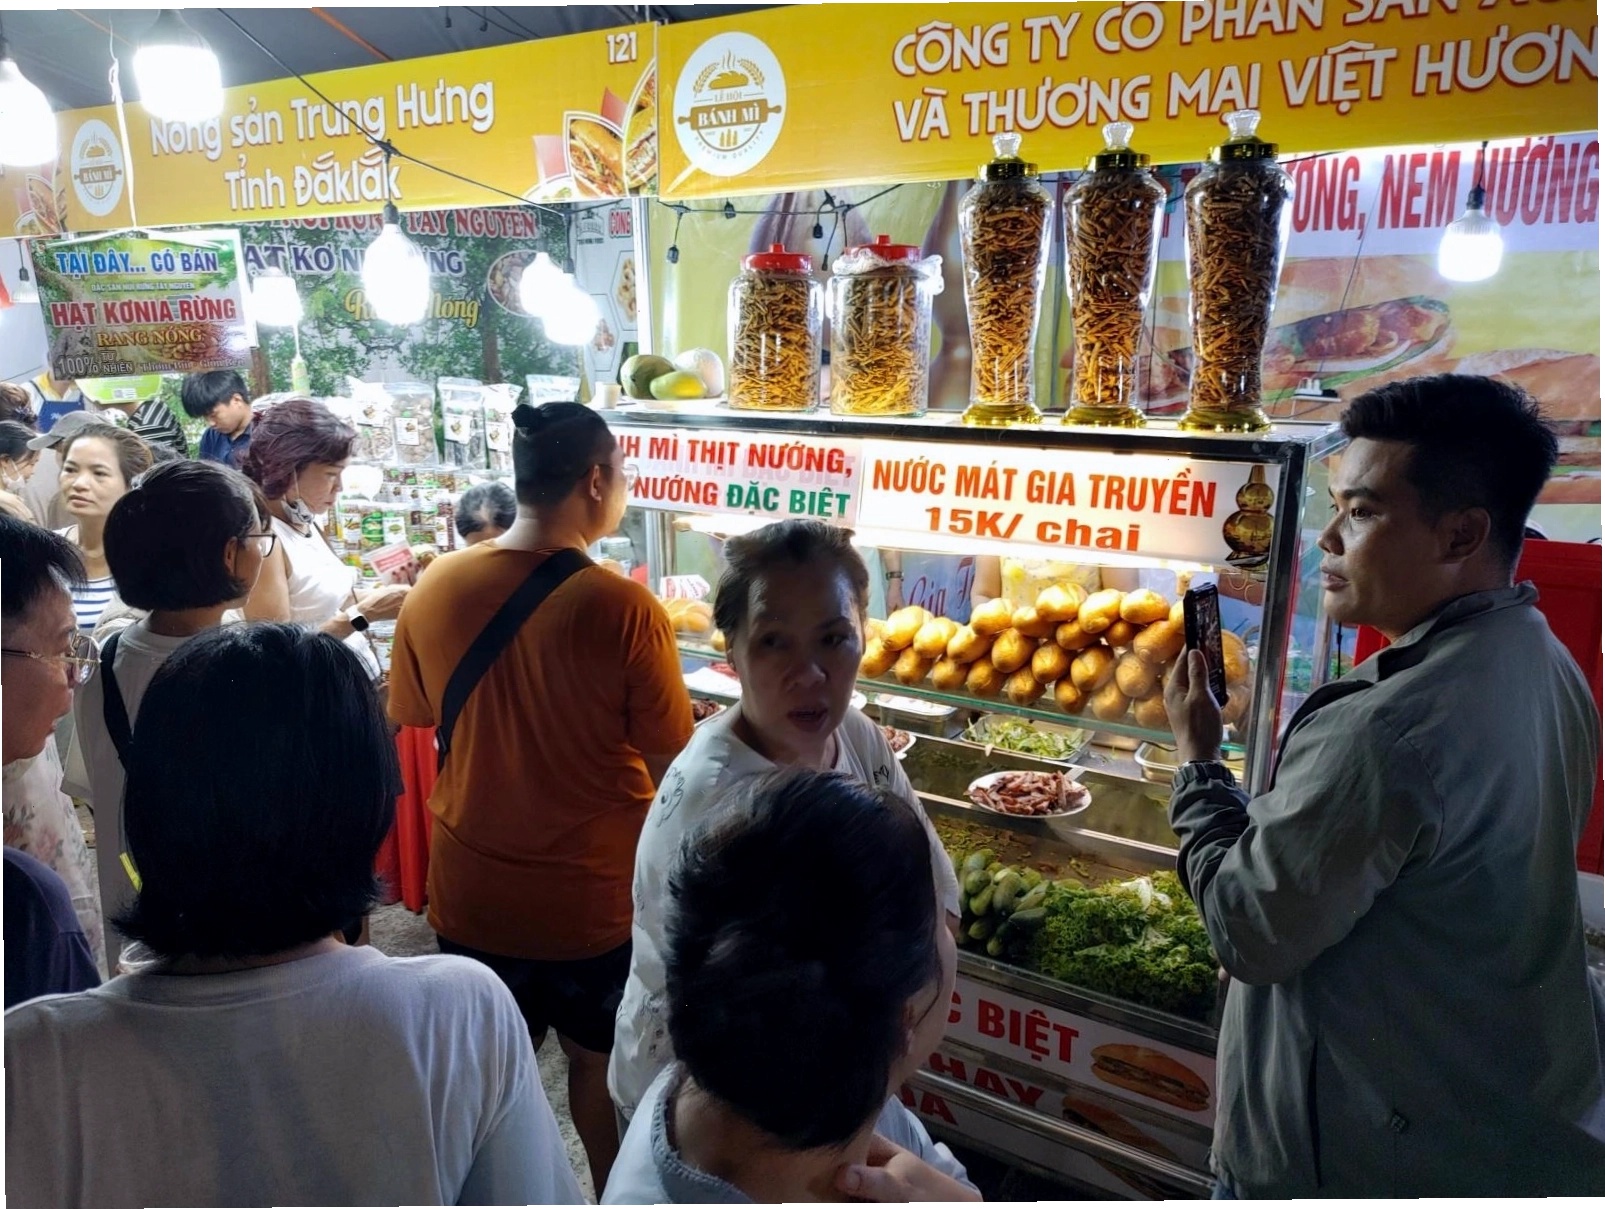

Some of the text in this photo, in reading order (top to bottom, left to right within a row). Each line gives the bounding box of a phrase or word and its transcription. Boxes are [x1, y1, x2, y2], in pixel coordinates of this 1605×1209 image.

[606, 31, 638, 65] 121
[893, 20, 1010, 76] CÔNG
[1023, 11, 1082, 62] TY
[893, 86, 951, 142] VÀ
[962, 76, 1151, 136] THƯƠNG
[1278, 39, 1398, 115] VIỆT
[229, 96, 284, 149] sản
[289, 97, 385, 145] Trung
[396, 78, 496, 134] Hưng
[698, 101, 761, 127] BÁNH MÌ
[223, 150, 403, 211] Tỉnh Đắklắk
[1377, 151, 1461, 229] NEM
[1472, 134, 1600, 228] NƯỚNG
[455, 205, 537, 238] NGUYÊN
[55, 248, 218, 279] TẠI ĐÂY... CÓ BÁN
[291, 242, 335, 272] KƠ
[51, 295, 237, 331] HẠT KƠNIA RỪNG
[97, 326, 202, 348] RANG NÓNG
[57, 355, 99, 376] 100%
[649, 433, 679, 461] MÌ
[687, 438, 740, 470] THỊT
[747, 440, 854, 478] NƯỚNG,
[633, 474, 851, 521] NƯỚNG ĐẶC BIỆT
[872, 456, 947, 496] NƯỚC
[955, 459, 1018, 501] MÁT
[1025, 469, 1076, 507] GIA
[1089, 466, 1218, 518] TRUYỀN
[924, 506, 1142, 552] 15K/ chai
[977, 998, 1080, 1064] BIỆT
